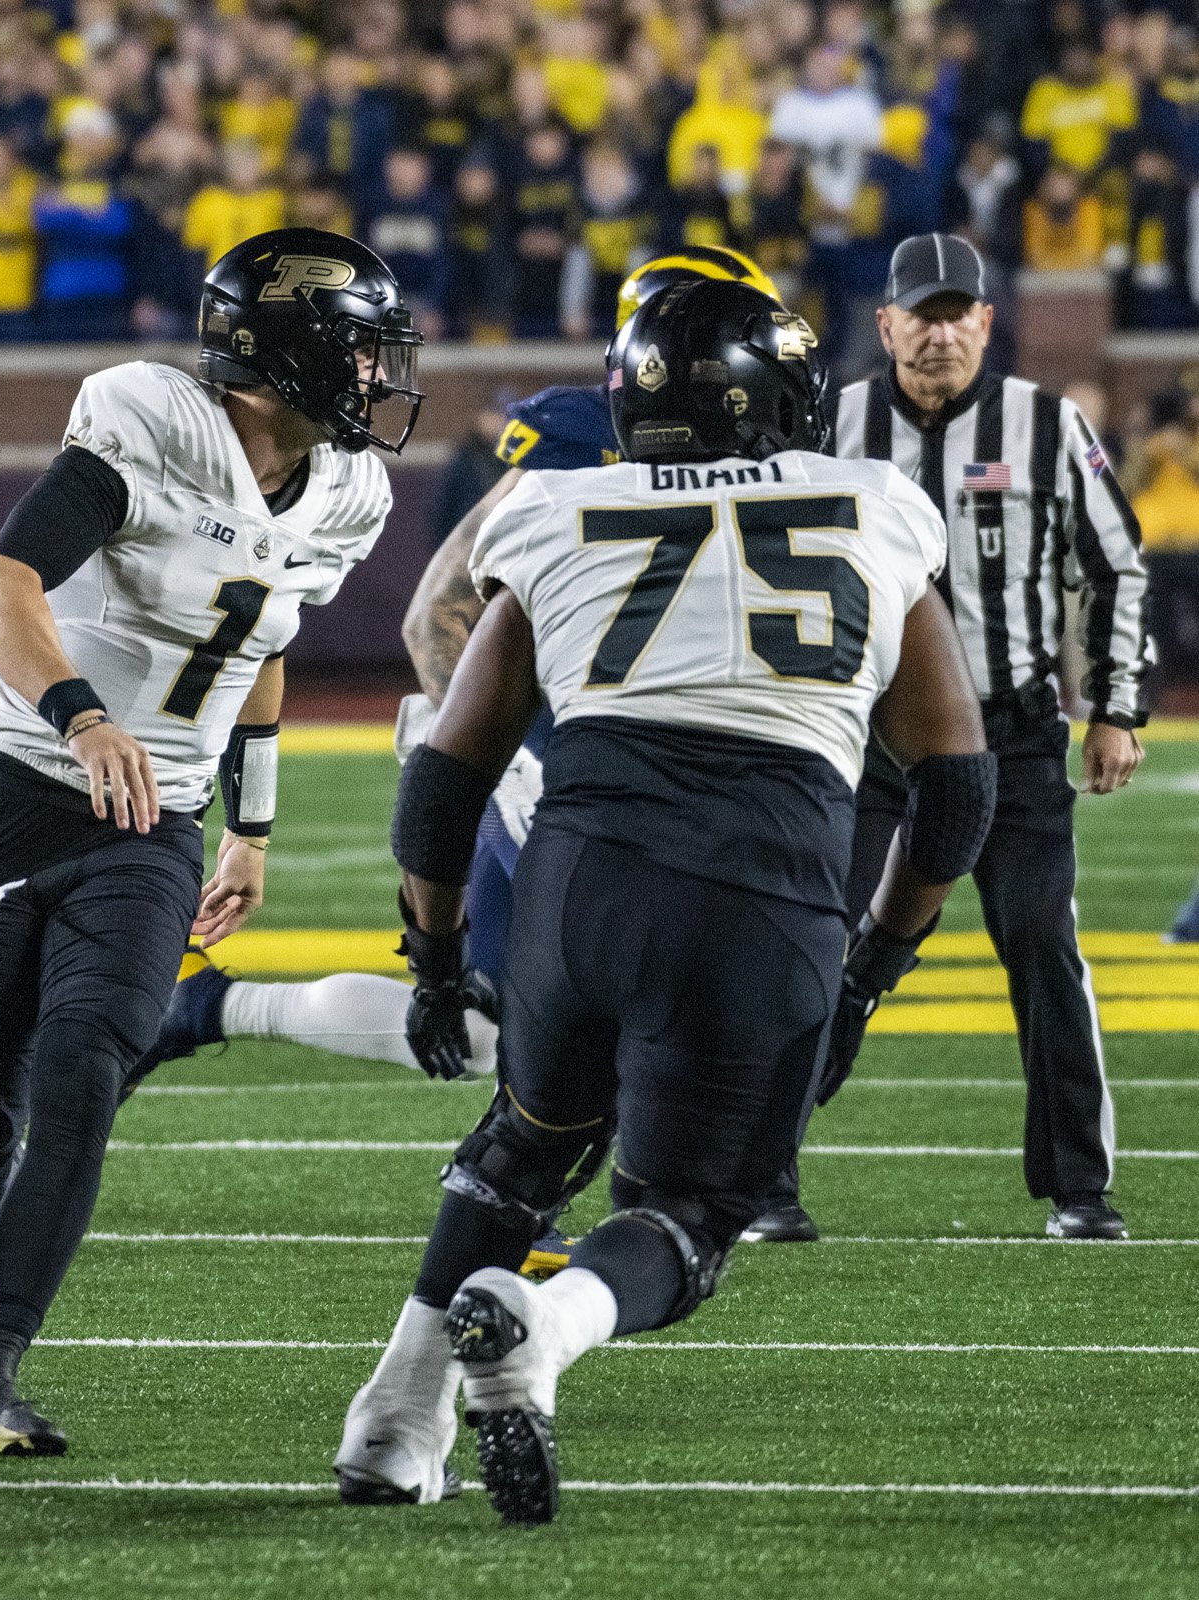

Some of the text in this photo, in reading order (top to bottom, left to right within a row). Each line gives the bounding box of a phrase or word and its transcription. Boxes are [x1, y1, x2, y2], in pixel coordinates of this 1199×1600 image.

[257, 254, 356, 302] P
[496, 419, 540, 467] 17
[979, 527, 1002, 558] U
[575, 493, 873, 691] 75
[156, 575, 274, 725] 1
